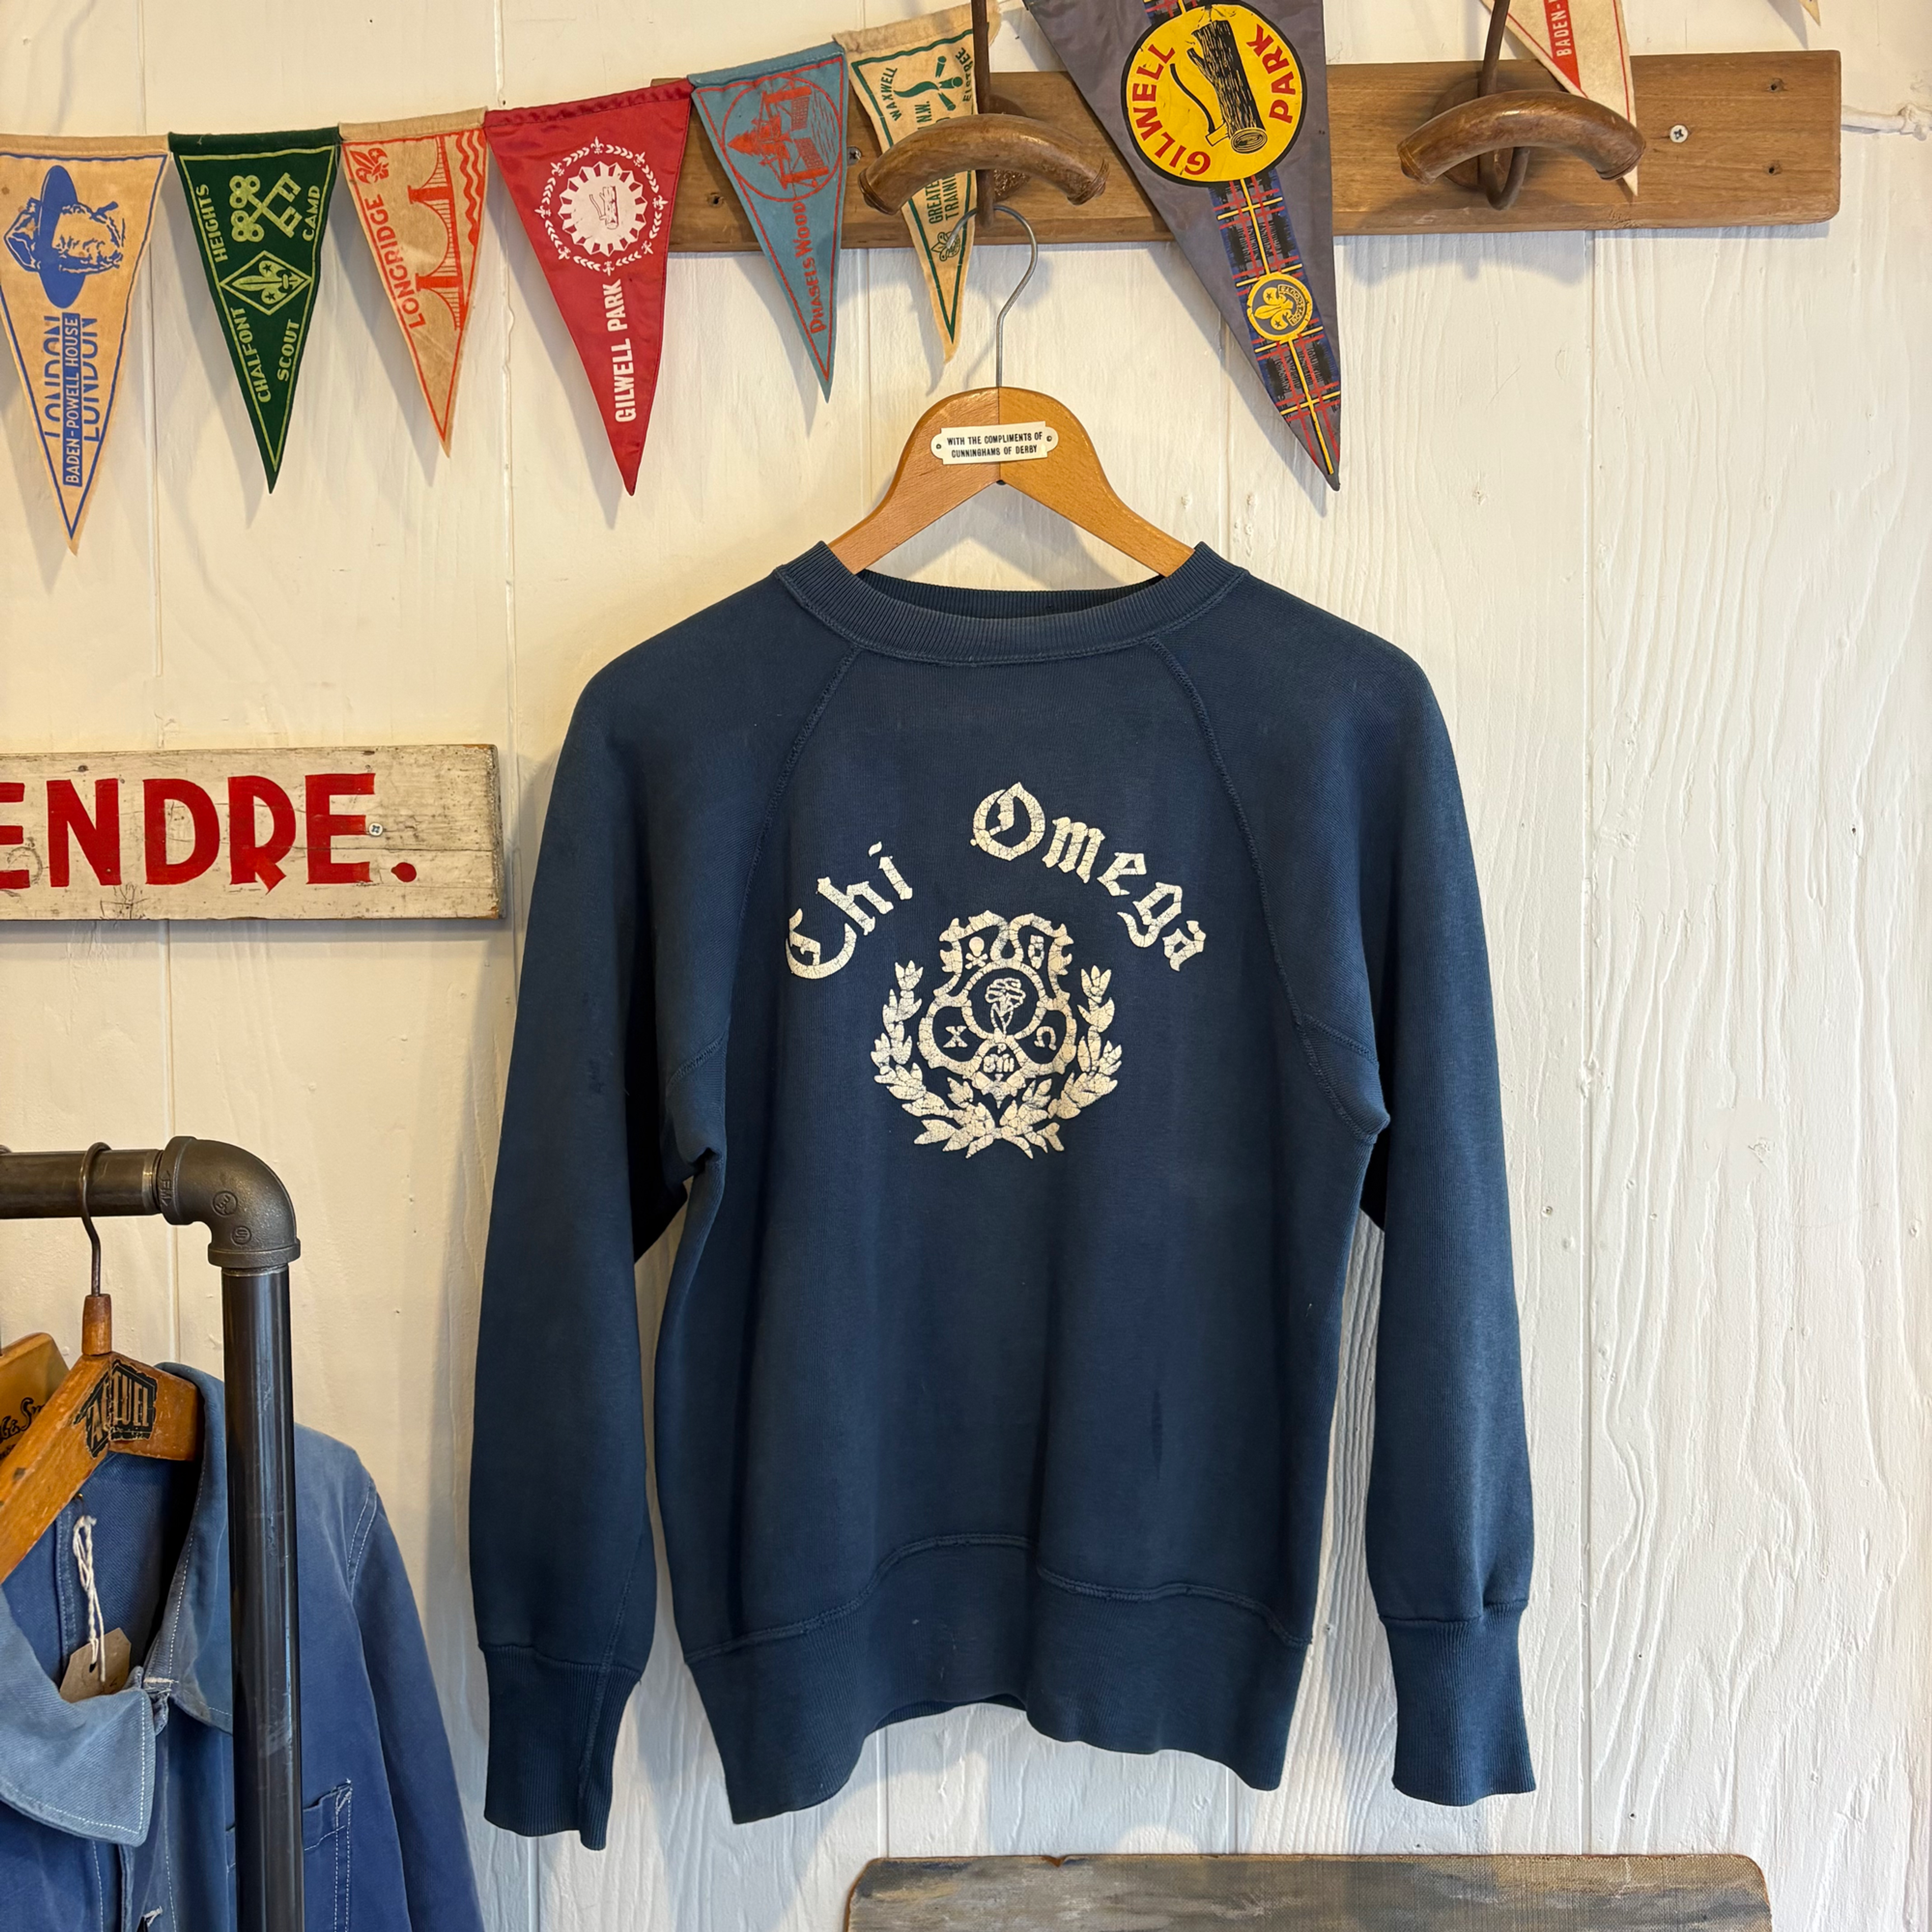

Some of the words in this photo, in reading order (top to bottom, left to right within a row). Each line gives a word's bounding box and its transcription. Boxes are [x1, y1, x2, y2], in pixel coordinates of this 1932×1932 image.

[1548, 0, 1572, 57] BADEN-
[881, 68, 902, 121] WAXWELL
[914, 101, 932, 123] N.W.
[1132, 44, 1211, 175] GILWELL
[1246, 23, 1296, 124] PARK
[196, 184, 228, 263] HEIGHTS
[925, 180, 943, 224] GREATE
[942, 174, 959, 221] TRAINI
[792, 202, 813, 258] WOOD
[277, 319, 300, 382] SCOUT
[302, 185, 321, 242] CAMP
[364, 193, 426, 329] LONGRIDGE
[602, 278, 628, 331] PARK
[802, 256, 827, 334] PHASELS
[64, 317, 79, 367] HOUSE
[230, 307, 271, 403] CHALFONT
[611, 338, 637, 423] GILWELL
[64, 372, 81, 483] BADEN-POWELL
[947, 437, 965, 446] WITH
[968, 436, 981, 445] THE
[984, 432, 1032, 444] COMPLIMENTS
[1034, 432, 1043, 441] OF
[951, 447, 1000, 458] CUNNINGHAMS
[1003, 446, 1012, 455] OF
[1015, 445, 1037, 454] DERBY
[786, 842, 913, 979] Chi
[970, 782, 1206, 971] Omega
